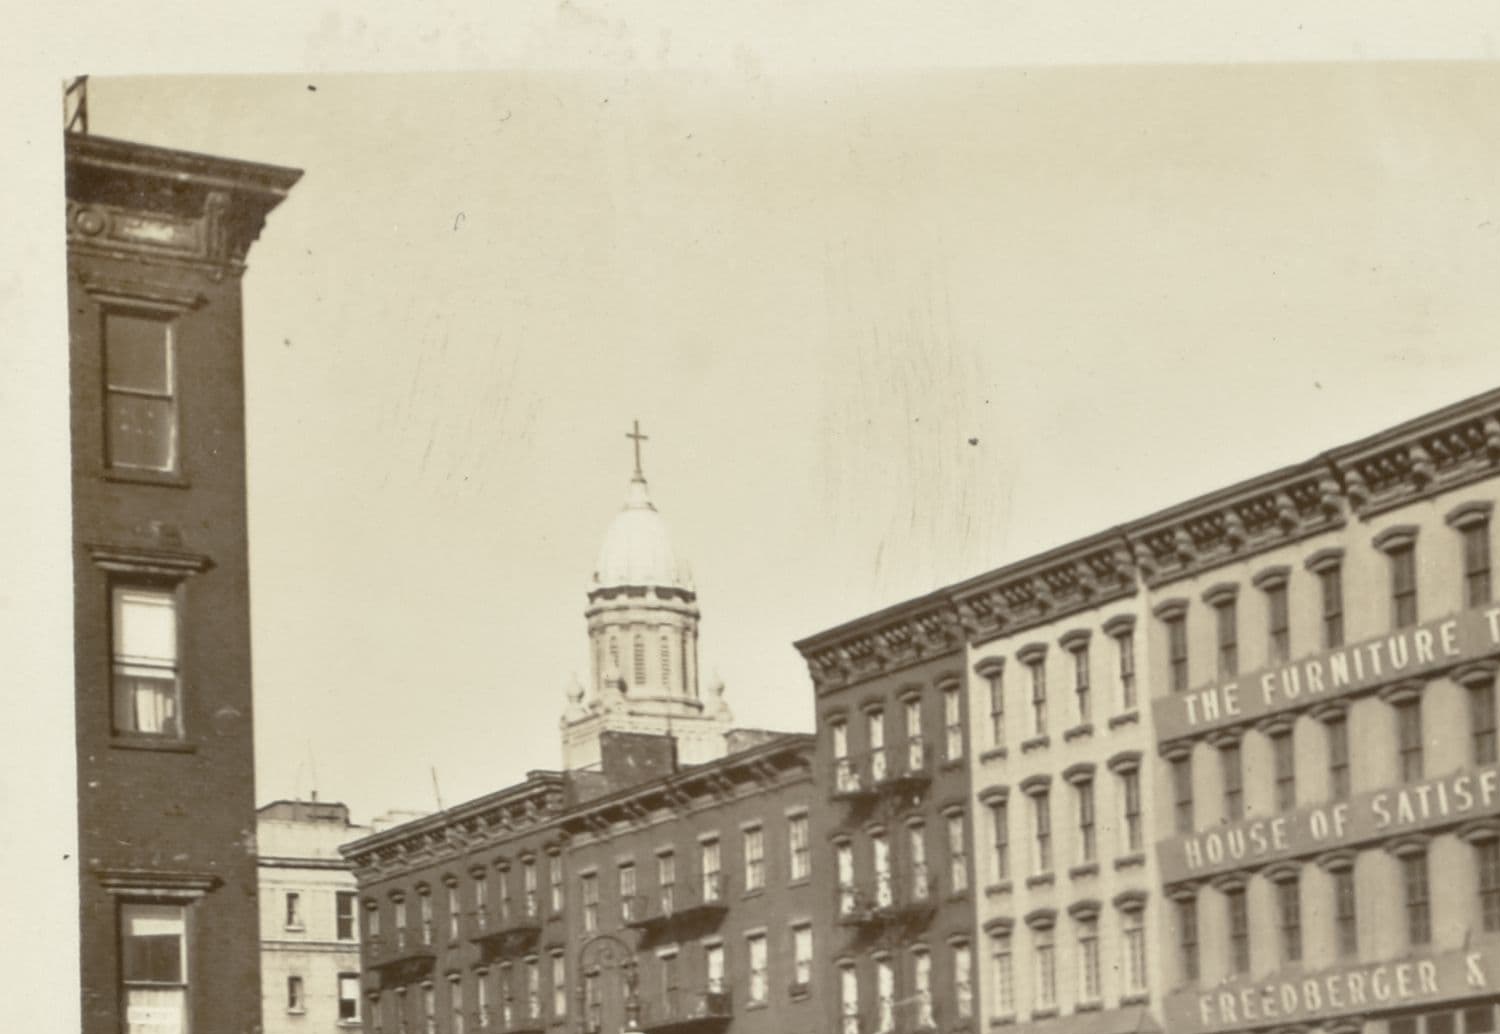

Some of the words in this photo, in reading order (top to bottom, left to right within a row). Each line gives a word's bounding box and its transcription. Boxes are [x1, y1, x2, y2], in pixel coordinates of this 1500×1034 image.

[1183, 683, 1241, 727] THE
[1261, 620, 1460, 706] FURNITURE
[1184, 814, 1289, 869] HOUSE
[1310, 801, 1349, 839] OF
[1198, 959, 1439, 1029] FREEDBERGER
[1466, 951, 1487, 989] &
